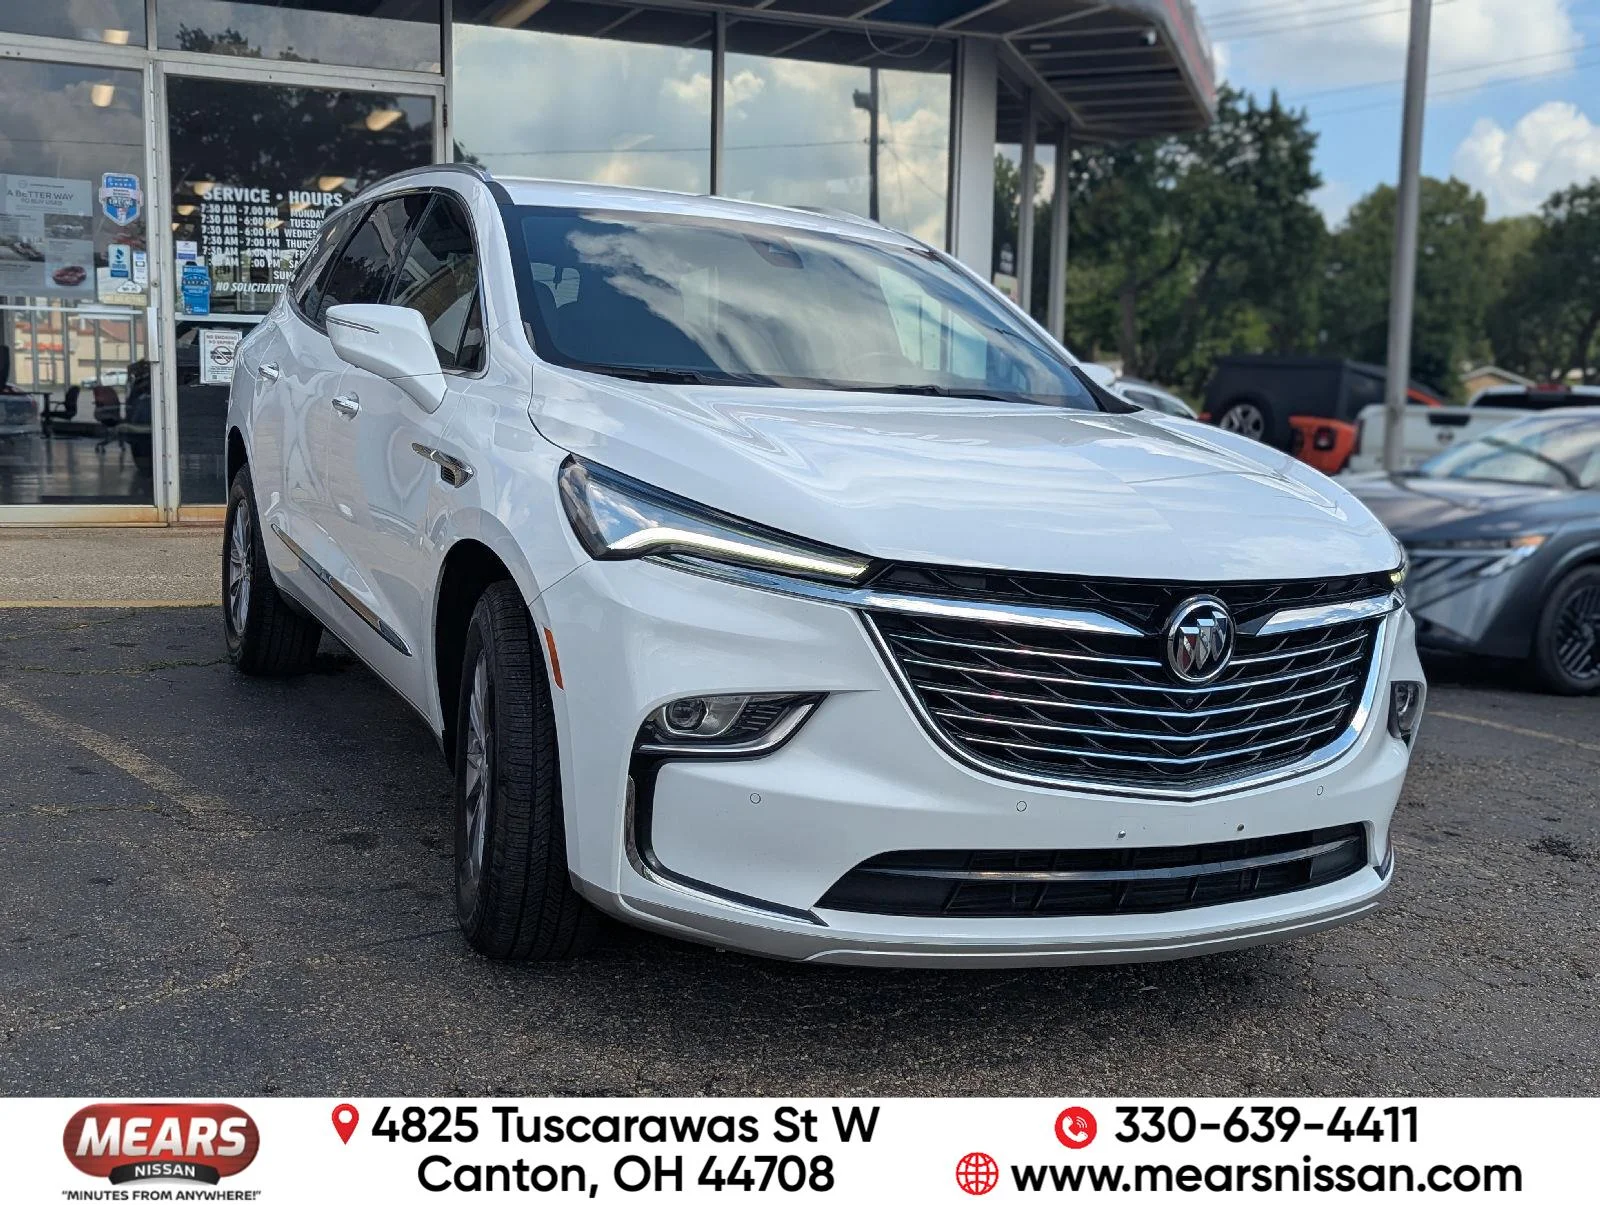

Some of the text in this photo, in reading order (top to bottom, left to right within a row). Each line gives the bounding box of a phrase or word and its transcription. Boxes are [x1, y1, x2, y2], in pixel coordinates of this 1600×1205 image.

[53, 192, 74, 201] WAY
[203, 187, 343, 207] SERVICE HOURS
[201, 203, 221, 214] 7:30
[222, 204, 237, 214] AM
[265, 207, 278, 216] PM
[290, 209, 326, 219] MONDAY
[201, 214, 221, 224] 7:30
[223, 215, 238, 225] AM
[244, 216, 264, 227] 6:00
[265, 217, 279, 228] PM
[201, 225, 221, 235] 7:30
[223, 226, 238, 236] AM
[244, 227, 264, 237] 6:00
[265, 228, 280, 238] PM
[202, 236, 222, 246] 7:30
[224, 237, 239, 246] AM
[245, 238, 265, 248] 7:00
[267, 239, 280, 248] PM
[225, 247, 239, 257] AM
[266, 249, 280, 259] PM
[225, 257, 239, 267] AM
[267, 260, 281, 270] PM
[215, 282, 285, 294] NO SOLICITATIO
